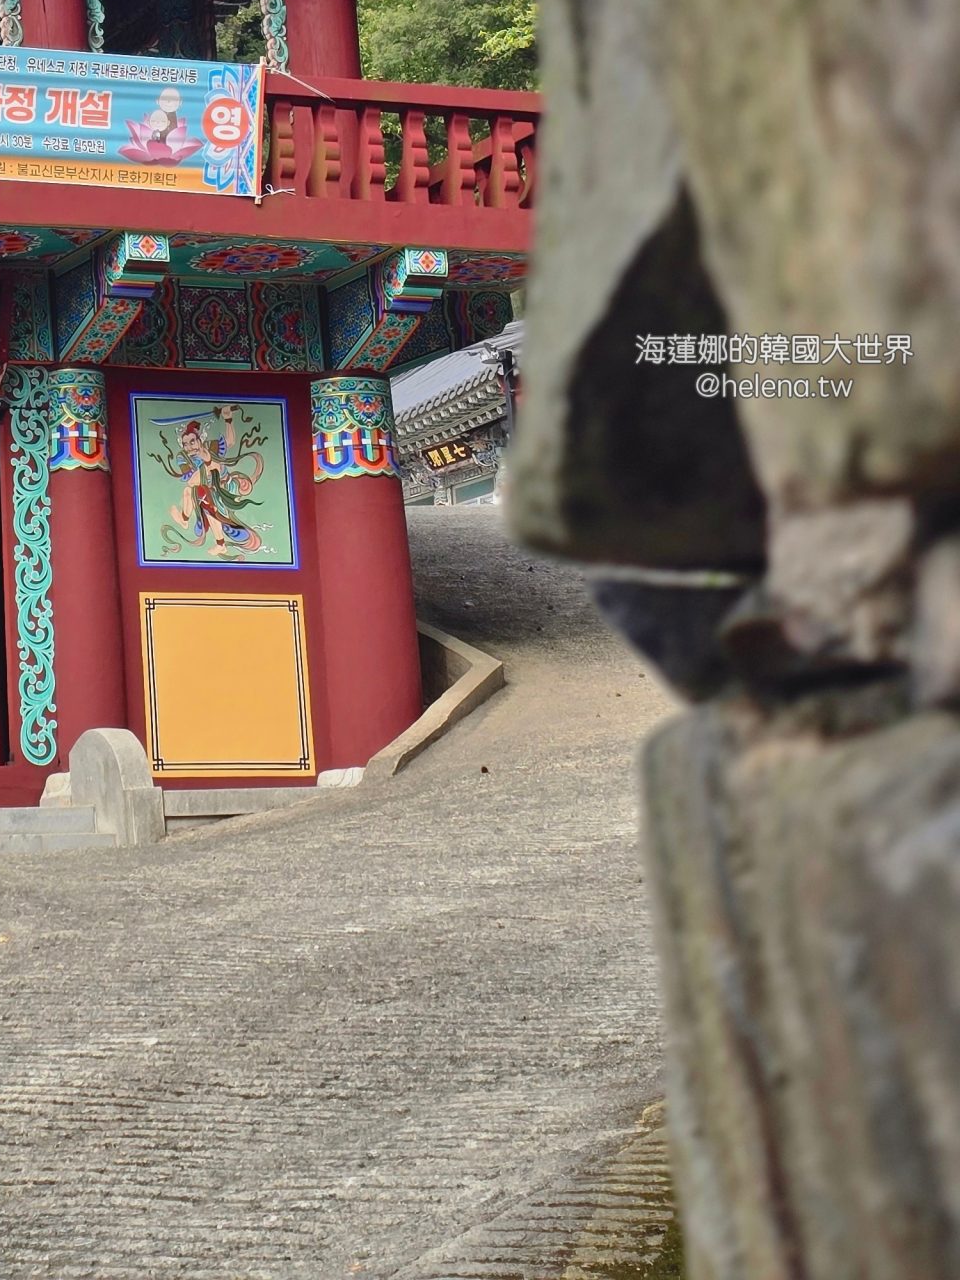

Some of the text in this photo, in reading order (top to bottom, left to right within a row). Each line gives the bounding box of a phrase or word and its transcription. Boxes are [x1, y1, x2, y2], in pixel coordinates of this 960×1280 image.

[26, 58, 66, 75] 유네스코
[69, 61, 88, 77] 지정
[46, 90, 111, 127] 개설
[210, 105, 243, 141] 영
[12, 135, 34, 149] 30분
[42, 137, 71, 152] 수강료
[16, 162, 115, 183] 불교신문부산지사
[117, 169, 179, 187] 문화기획단
